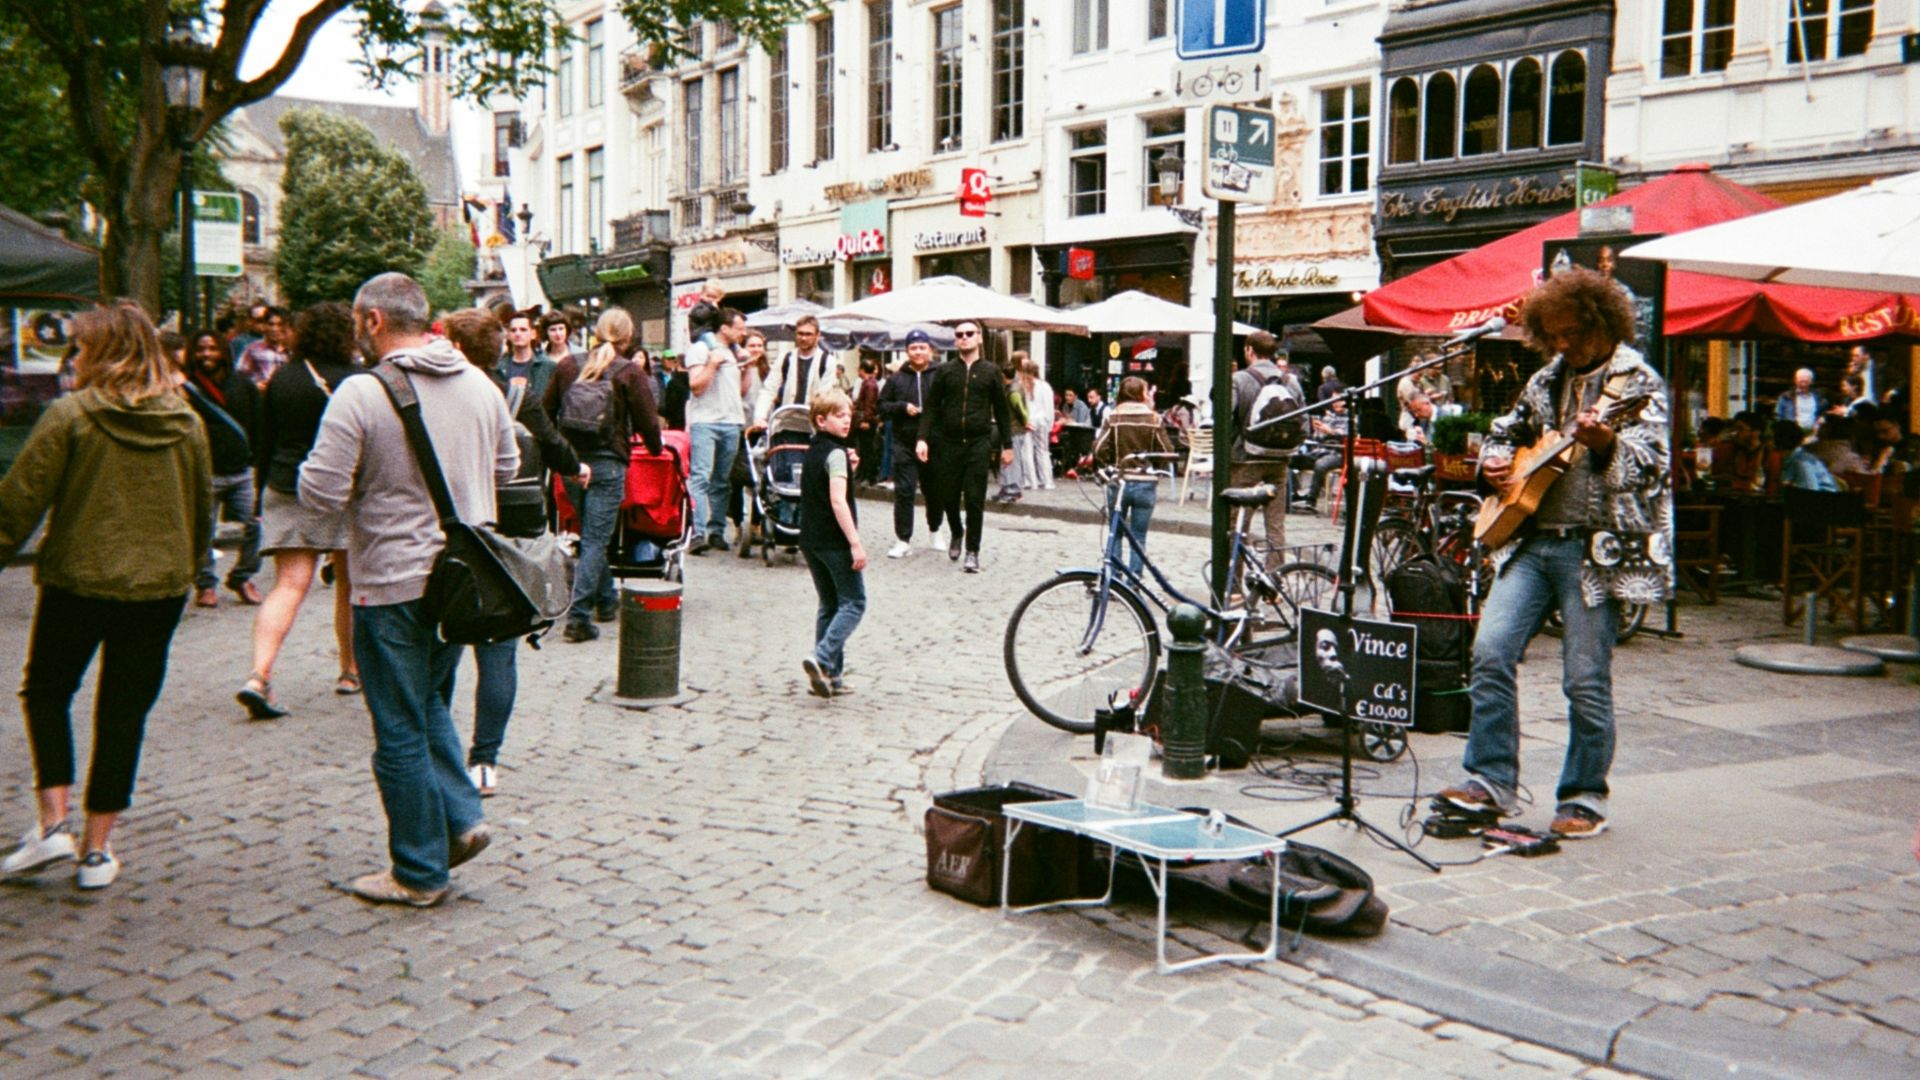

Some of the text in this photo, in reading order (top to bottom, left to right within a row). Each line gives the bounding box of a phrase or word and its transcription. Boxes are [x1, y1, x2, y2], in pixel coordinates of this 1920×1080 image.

[1222, 119, 1232, 134] 11
[969, 172, 988, 198] Q
[1380, 174, 1576, 223] The English House
[835, 228, 885, 261] Quick
[1255, 268, 1299, 290] Purple
[1300, 266, 1338, 287] Rose
[1347, 628, 1407, 658] Vince
[1373, 683, 1408, 700] Cd's
[1355, 700, 1408, 719] €10,00
